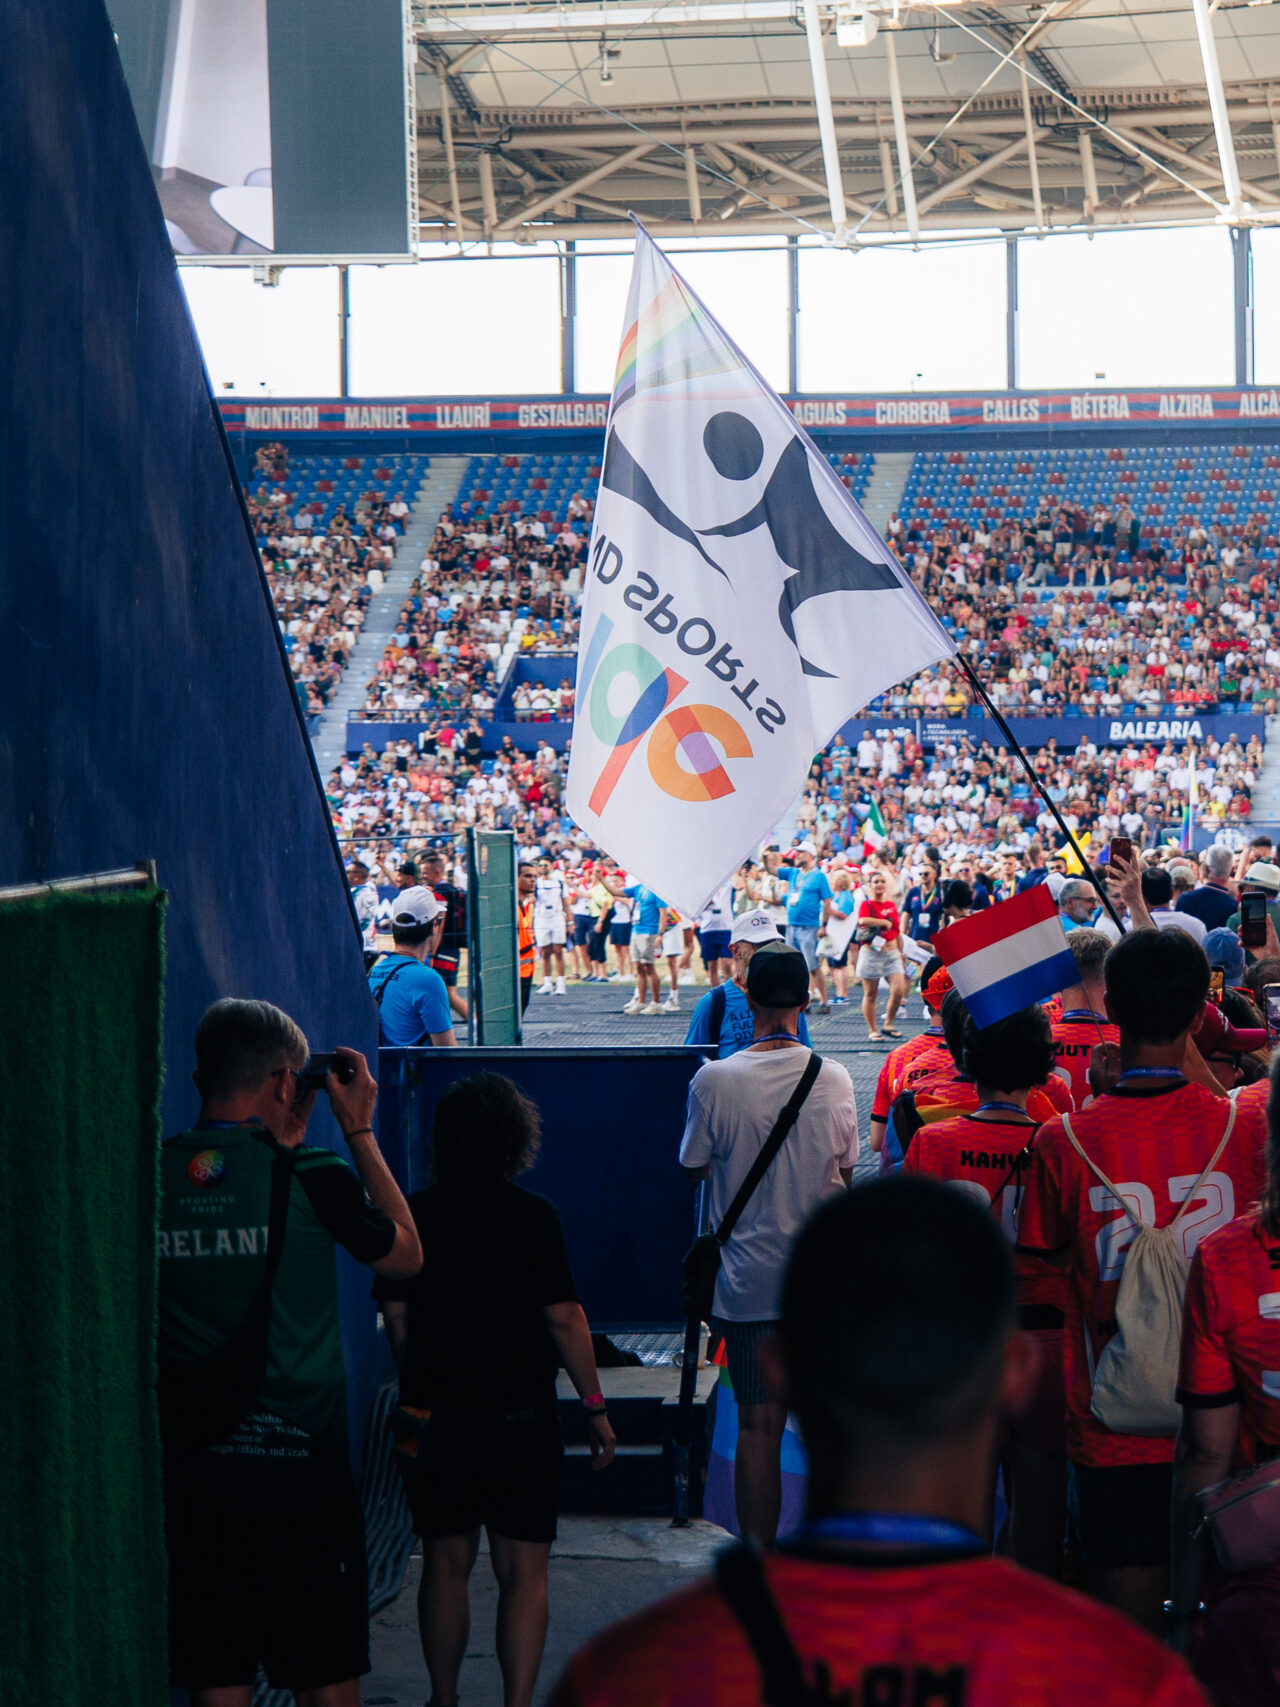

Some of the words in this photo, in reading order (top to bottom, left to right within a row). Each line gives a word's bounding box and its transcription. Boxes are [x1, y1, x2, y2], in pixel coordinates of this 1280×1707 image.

[344, 406, 410, 428] MANUEL
[436, 403, 491, 428] LLAURÍ
[518, 403, 608, 428] GESTALGAR
[794, 402, 847, 425] AGUAS
[876, 401, 951, 424] CORBERA
[983, 398, 1040, 421] CALLES
[1071, 392, 1129, 419] BÉTERA
[1159, 394, 1214, 417] ALZIRA
[1088, 1171, 1235, 1282] 22
[157, 1226, 270, 1258] RELAN
